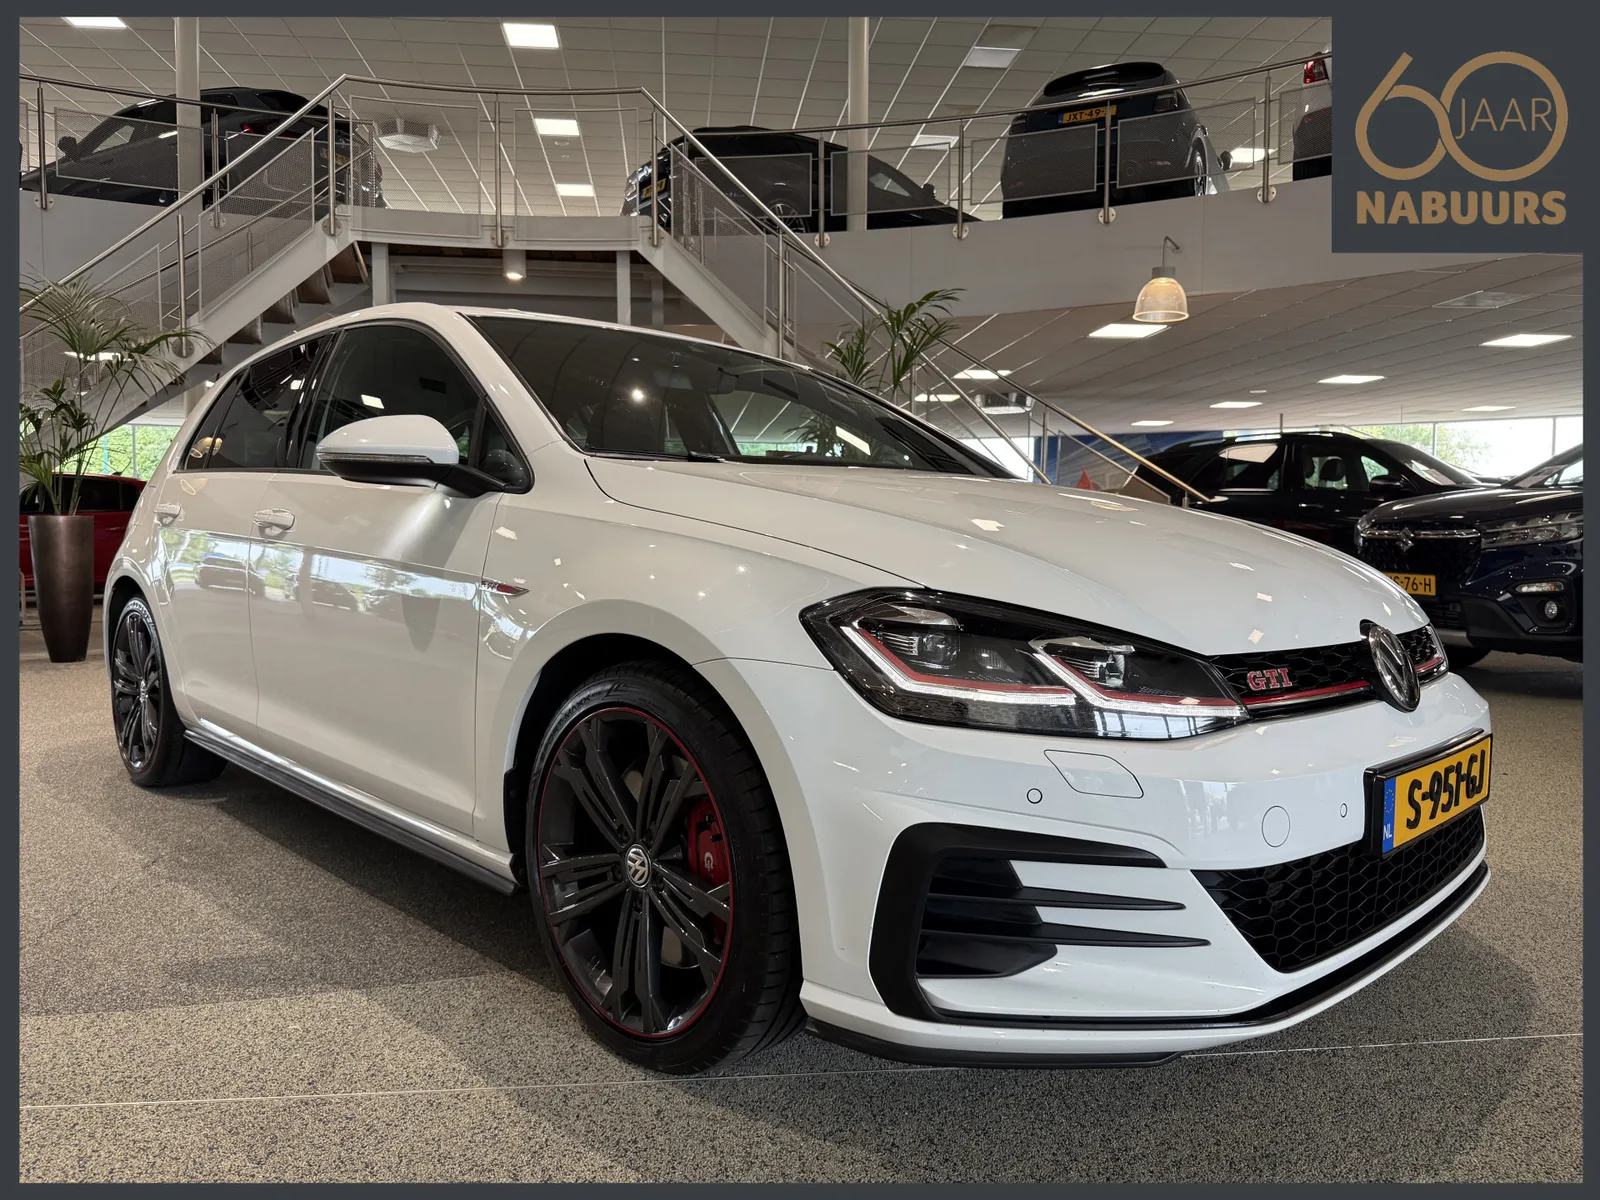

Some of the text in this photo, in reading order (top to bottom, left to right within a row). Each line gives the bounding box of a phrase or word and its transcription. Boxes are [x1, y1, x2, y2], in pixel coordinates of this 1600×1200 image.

[1067, 107, 1110, 122] JXT-49-
[1247, 667, 1293, 691] GTI
[1406, 749, 1486, 830] S-951-GJ
[1383, 822, 1393, 841] NL
